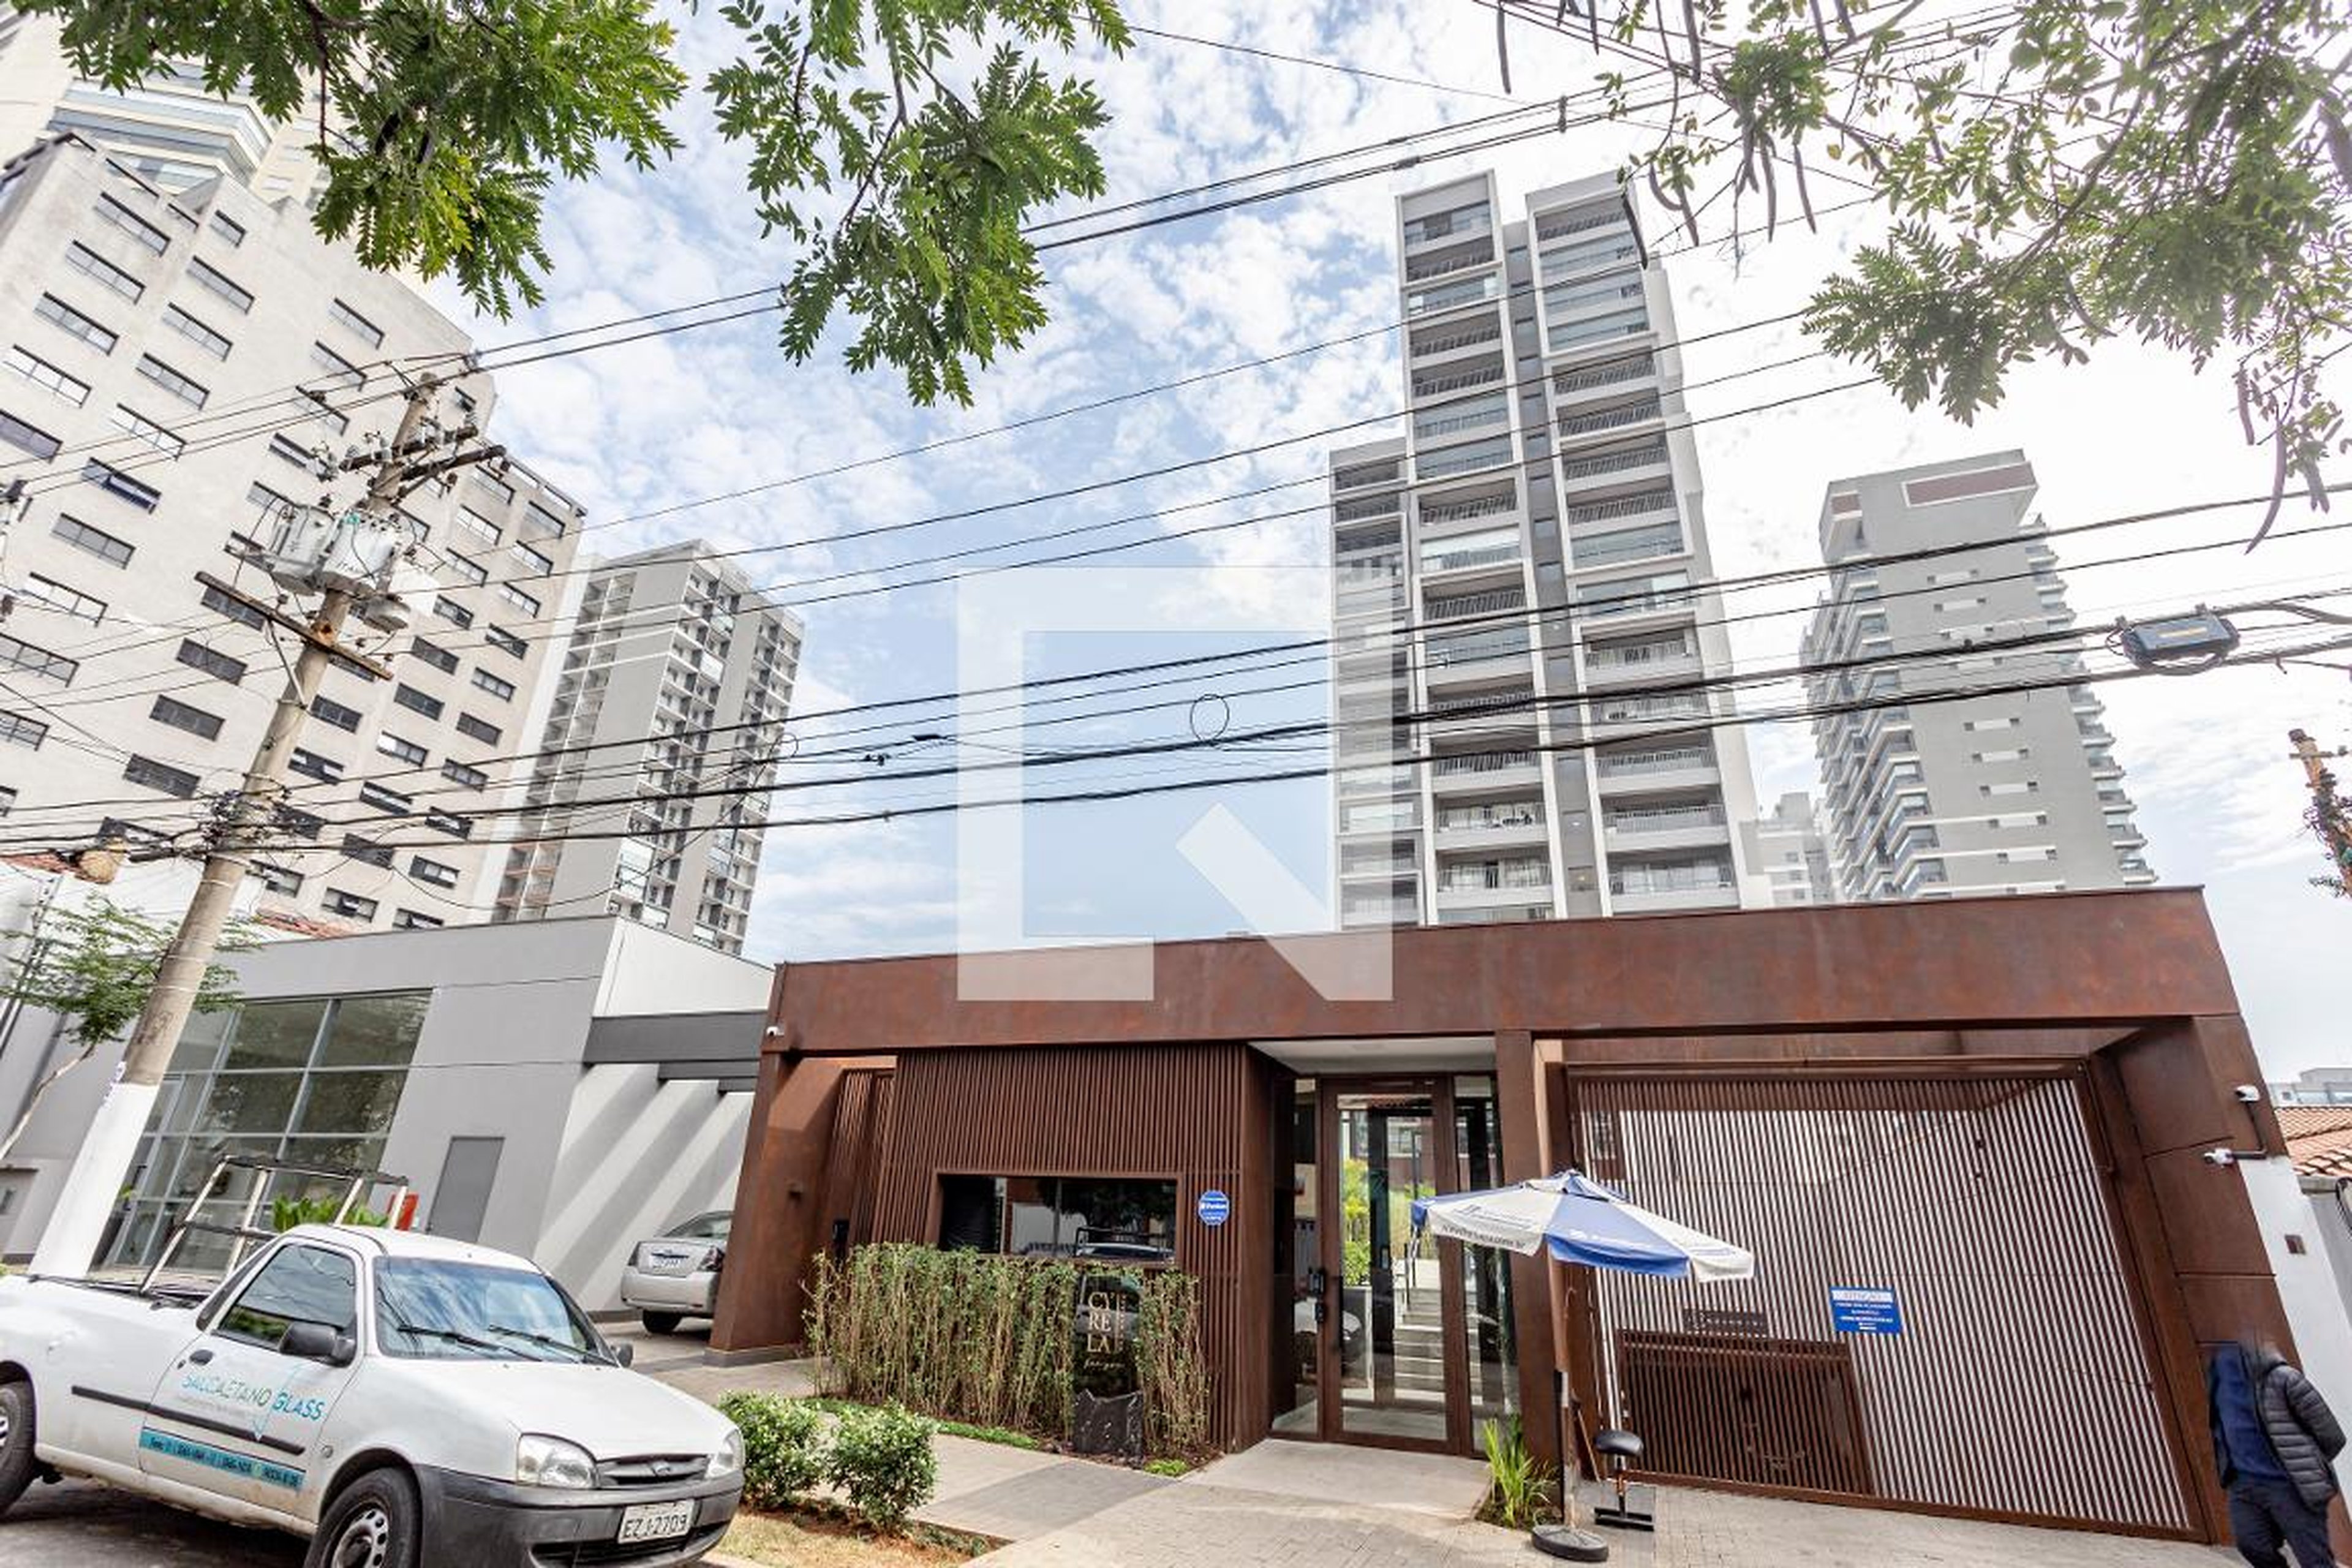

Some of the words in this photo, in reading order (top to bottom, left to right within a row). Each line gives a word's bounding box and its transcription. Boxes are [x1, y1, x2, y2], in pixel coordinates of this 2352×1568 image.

[1088, 1312, 1112, 1332] RE
[1086, 1332, 1112, 1354] LA
[272, 1391, 325, 1421] GLASS
